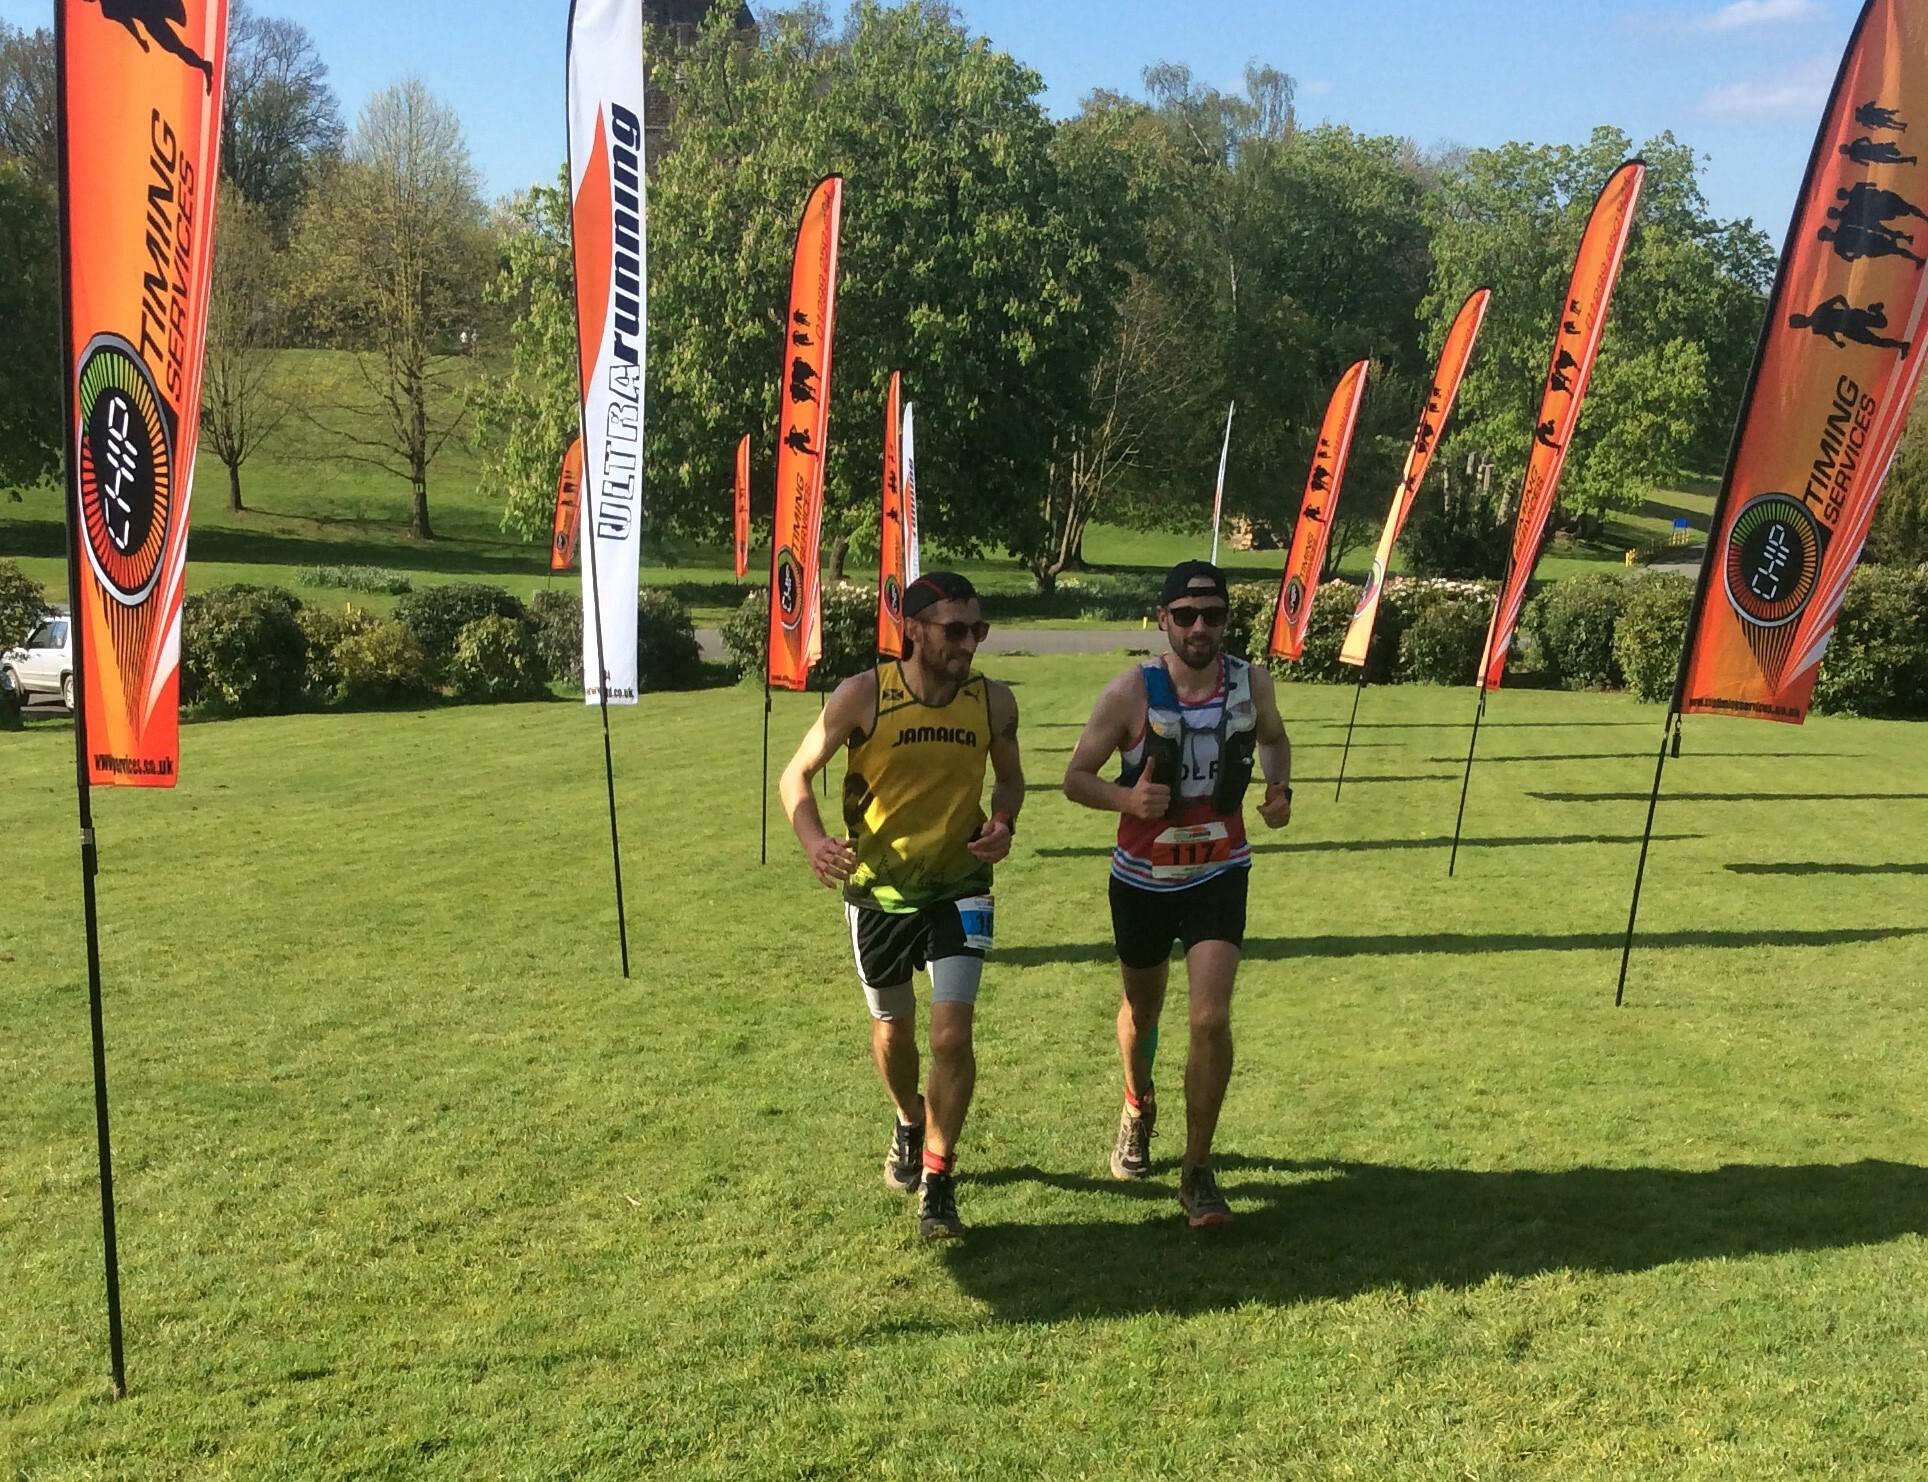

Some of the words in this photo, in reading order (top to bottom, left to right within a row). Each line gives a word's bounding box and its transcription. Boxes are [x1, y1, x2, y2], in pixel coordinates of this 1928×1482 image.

[140, 108, 178, 363] TIMING
[166, 150, 195, 401] SERVICES
[103, 396, 138, 550] CHIP
[1803, 374, 1858, 507] TIMING
[1824, 393, 1876, 525] SERVICES
[792, 472, 804, 552] TIMING
[1751, 523, 1790, 601] CHIP
[892, 726, 977, 748] JAMAICA
[1168, 840, 1216, 866] 117
